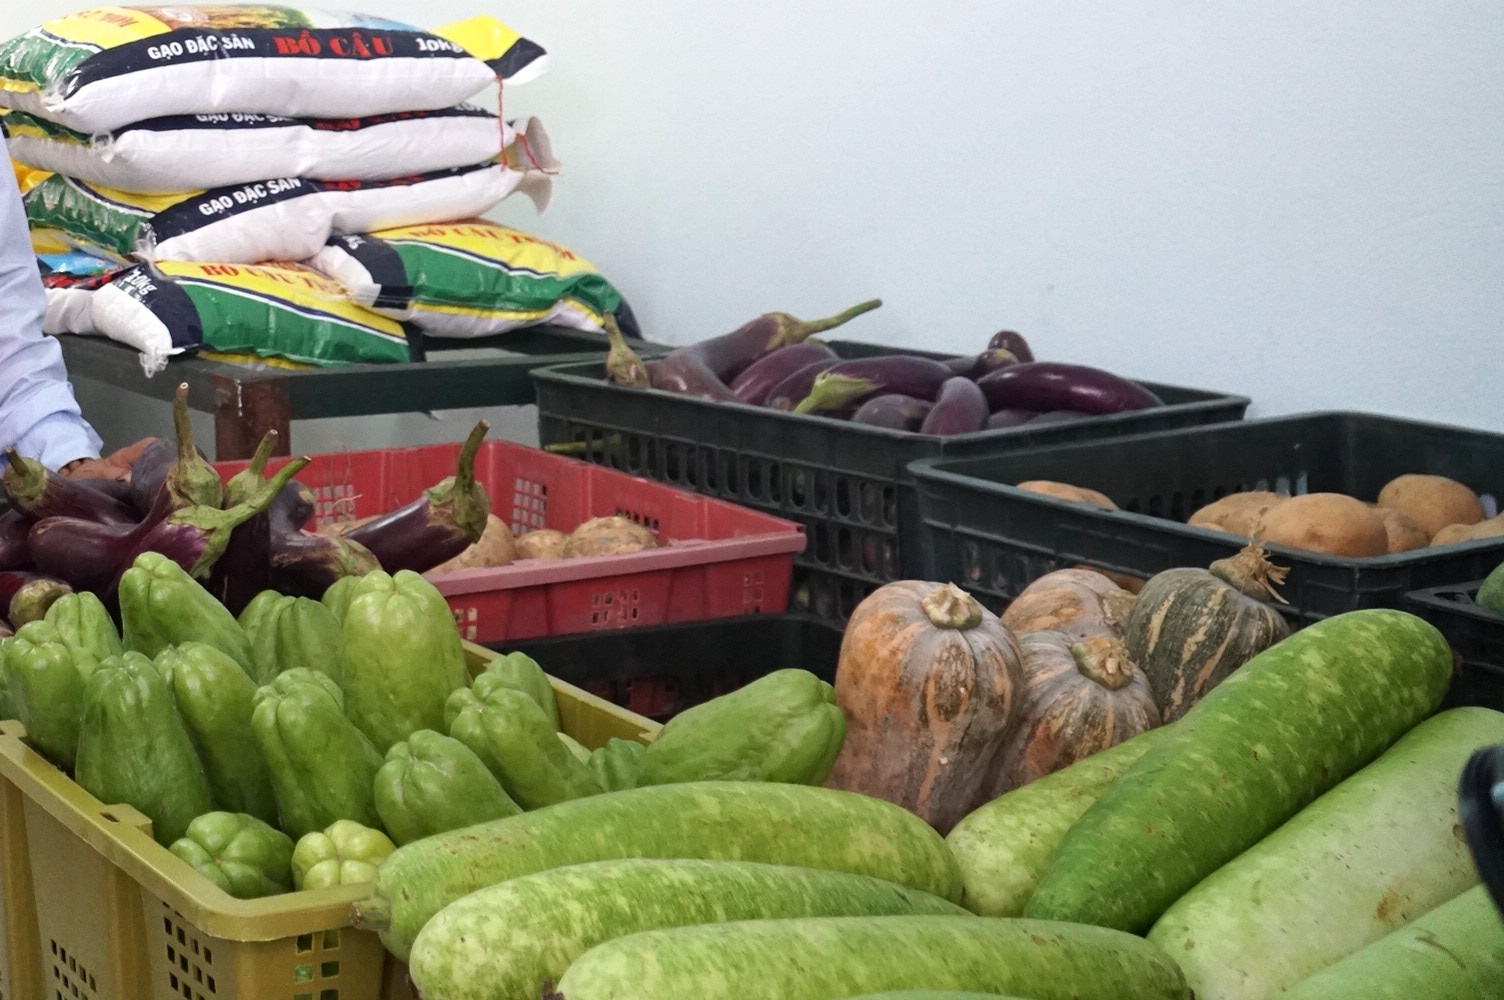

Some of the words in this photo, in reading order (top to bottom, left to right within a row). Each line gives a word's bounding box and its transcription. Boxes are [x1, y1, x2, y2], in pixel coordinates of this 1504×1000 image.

[147, 42, 183, 61] GẠO
[187, 35, 219, 57] ĐẶC
[221, 32, 256, 51] SẢN
[328, 31, 394, 59] CÂU
[198, 195, 234, 215] GẠO
[232, 184, 268, 205] ĐẶC
